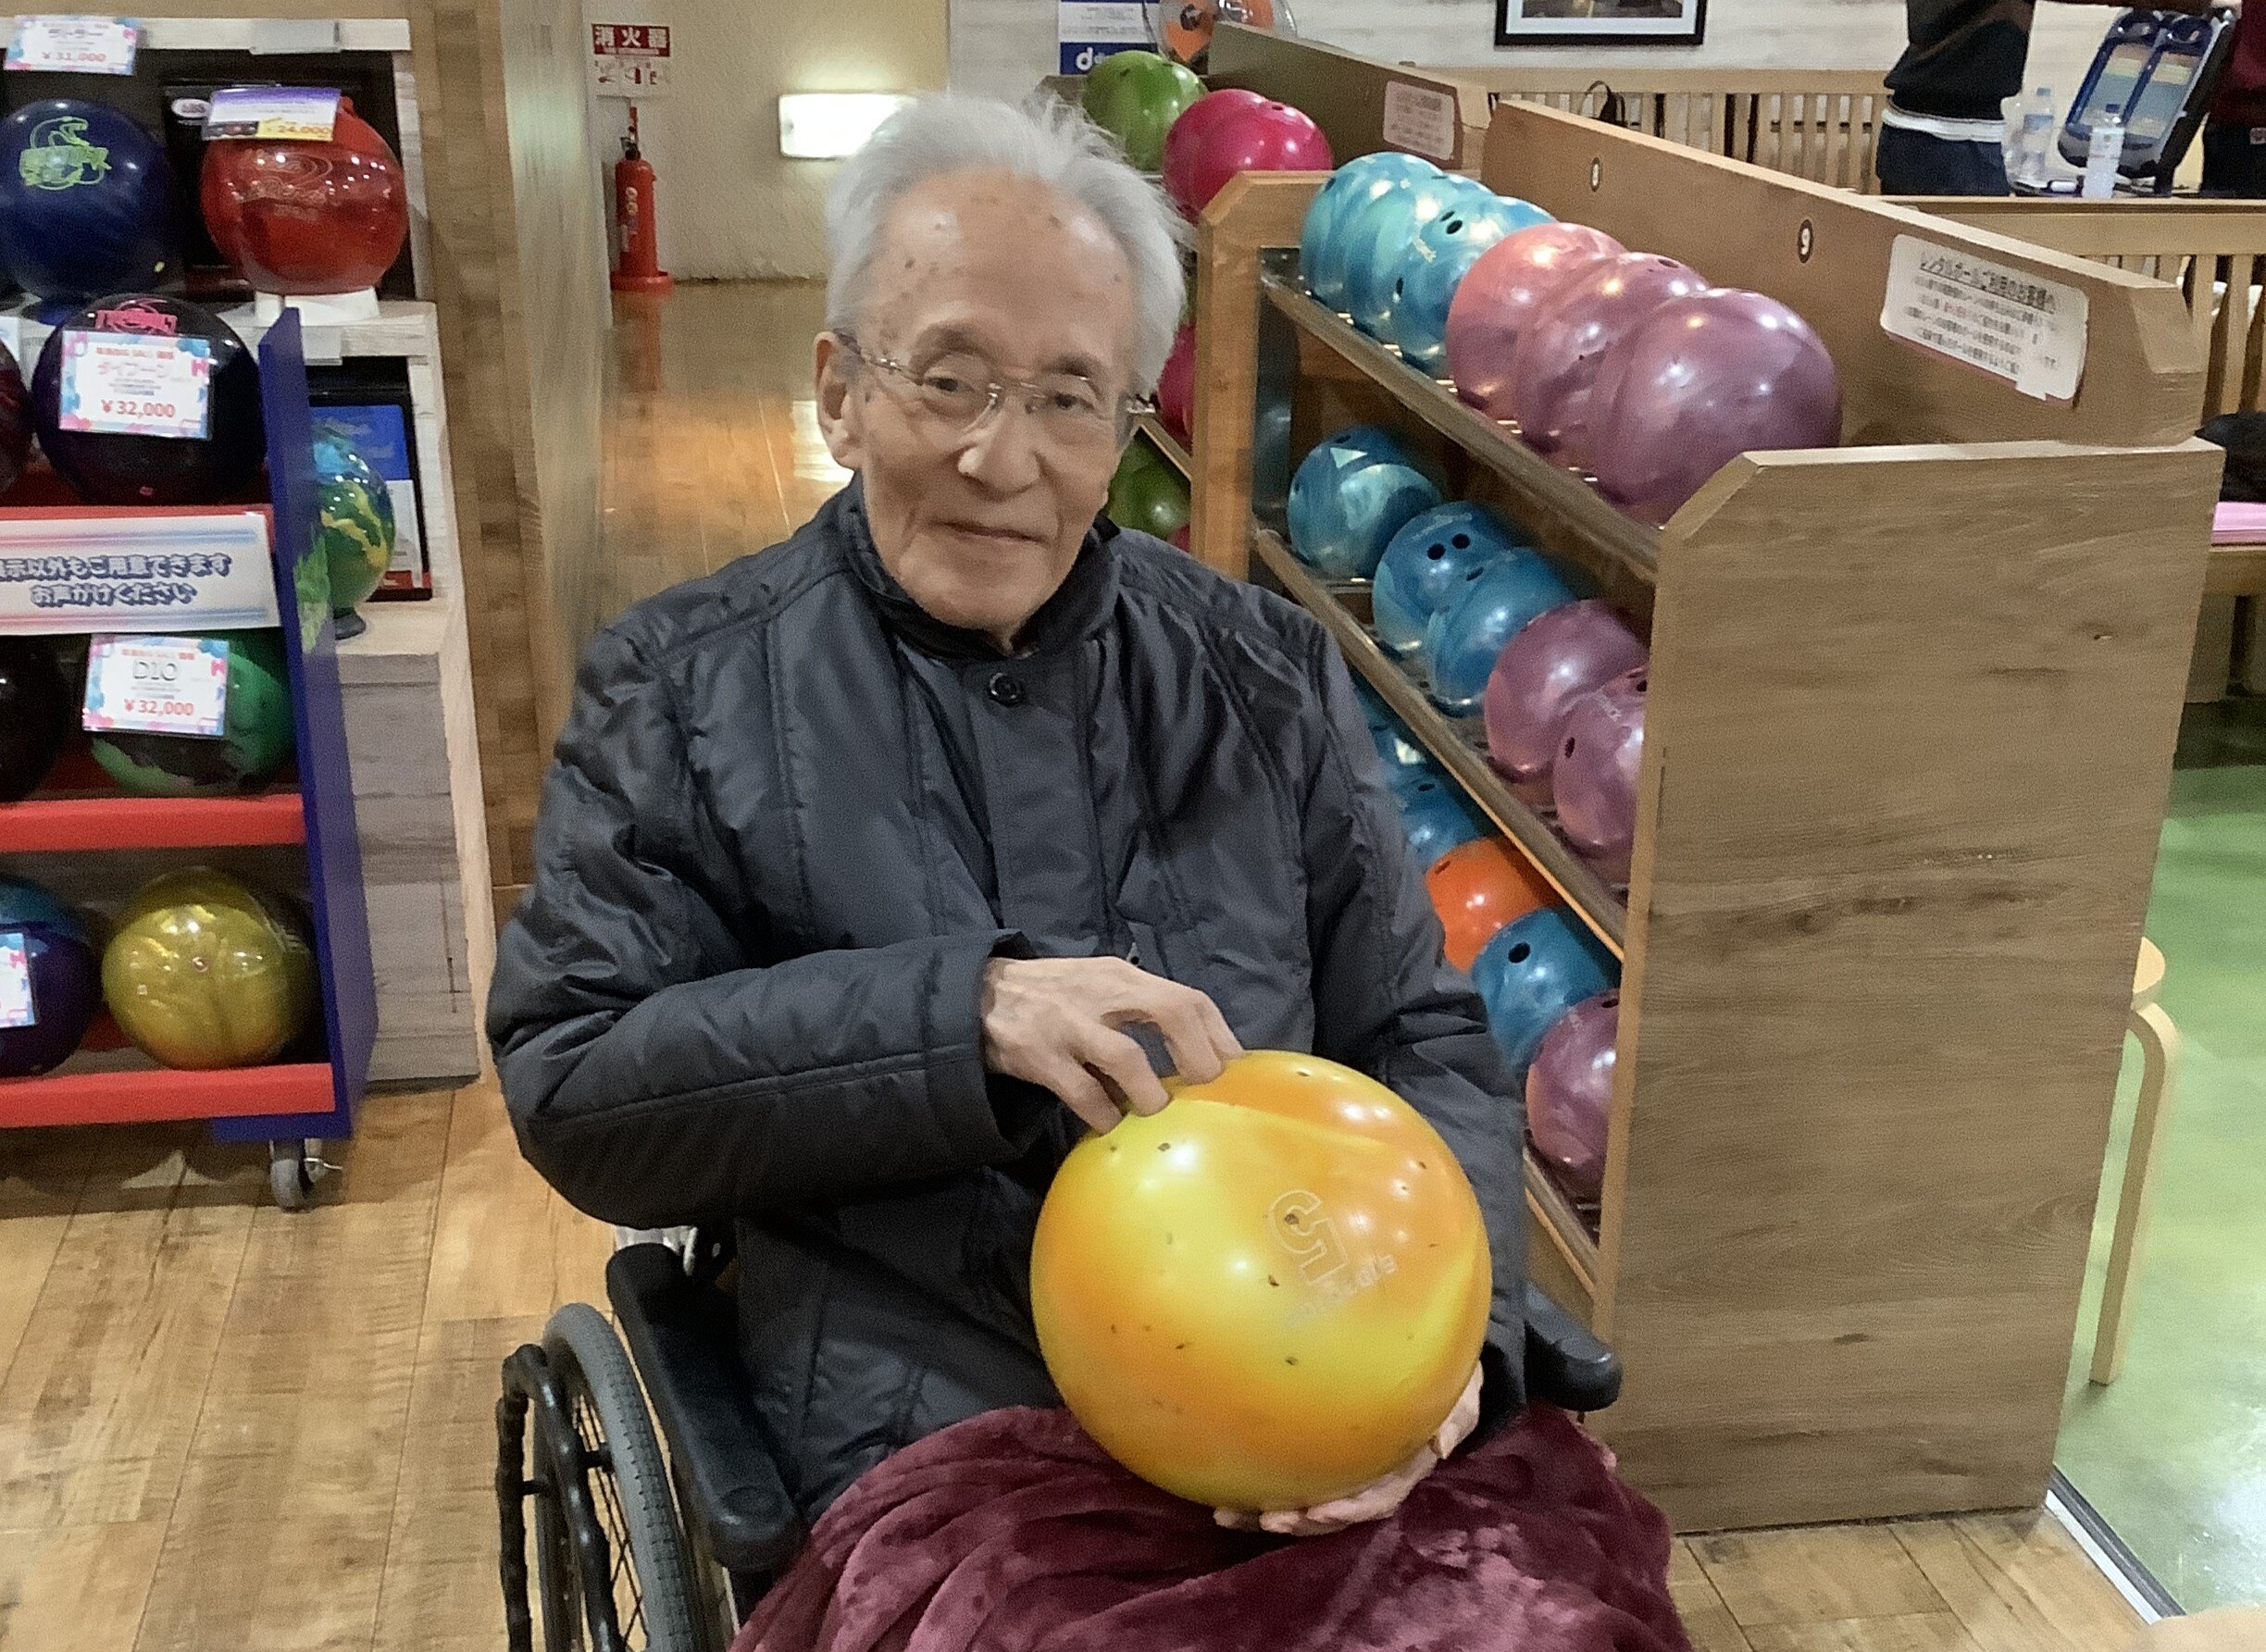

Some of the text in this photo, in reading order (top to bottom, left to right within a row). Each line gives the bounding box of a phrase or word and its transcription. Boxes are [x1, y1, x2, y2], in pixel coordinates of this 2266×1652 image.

[29, 582, 198, 607] お声がけください
